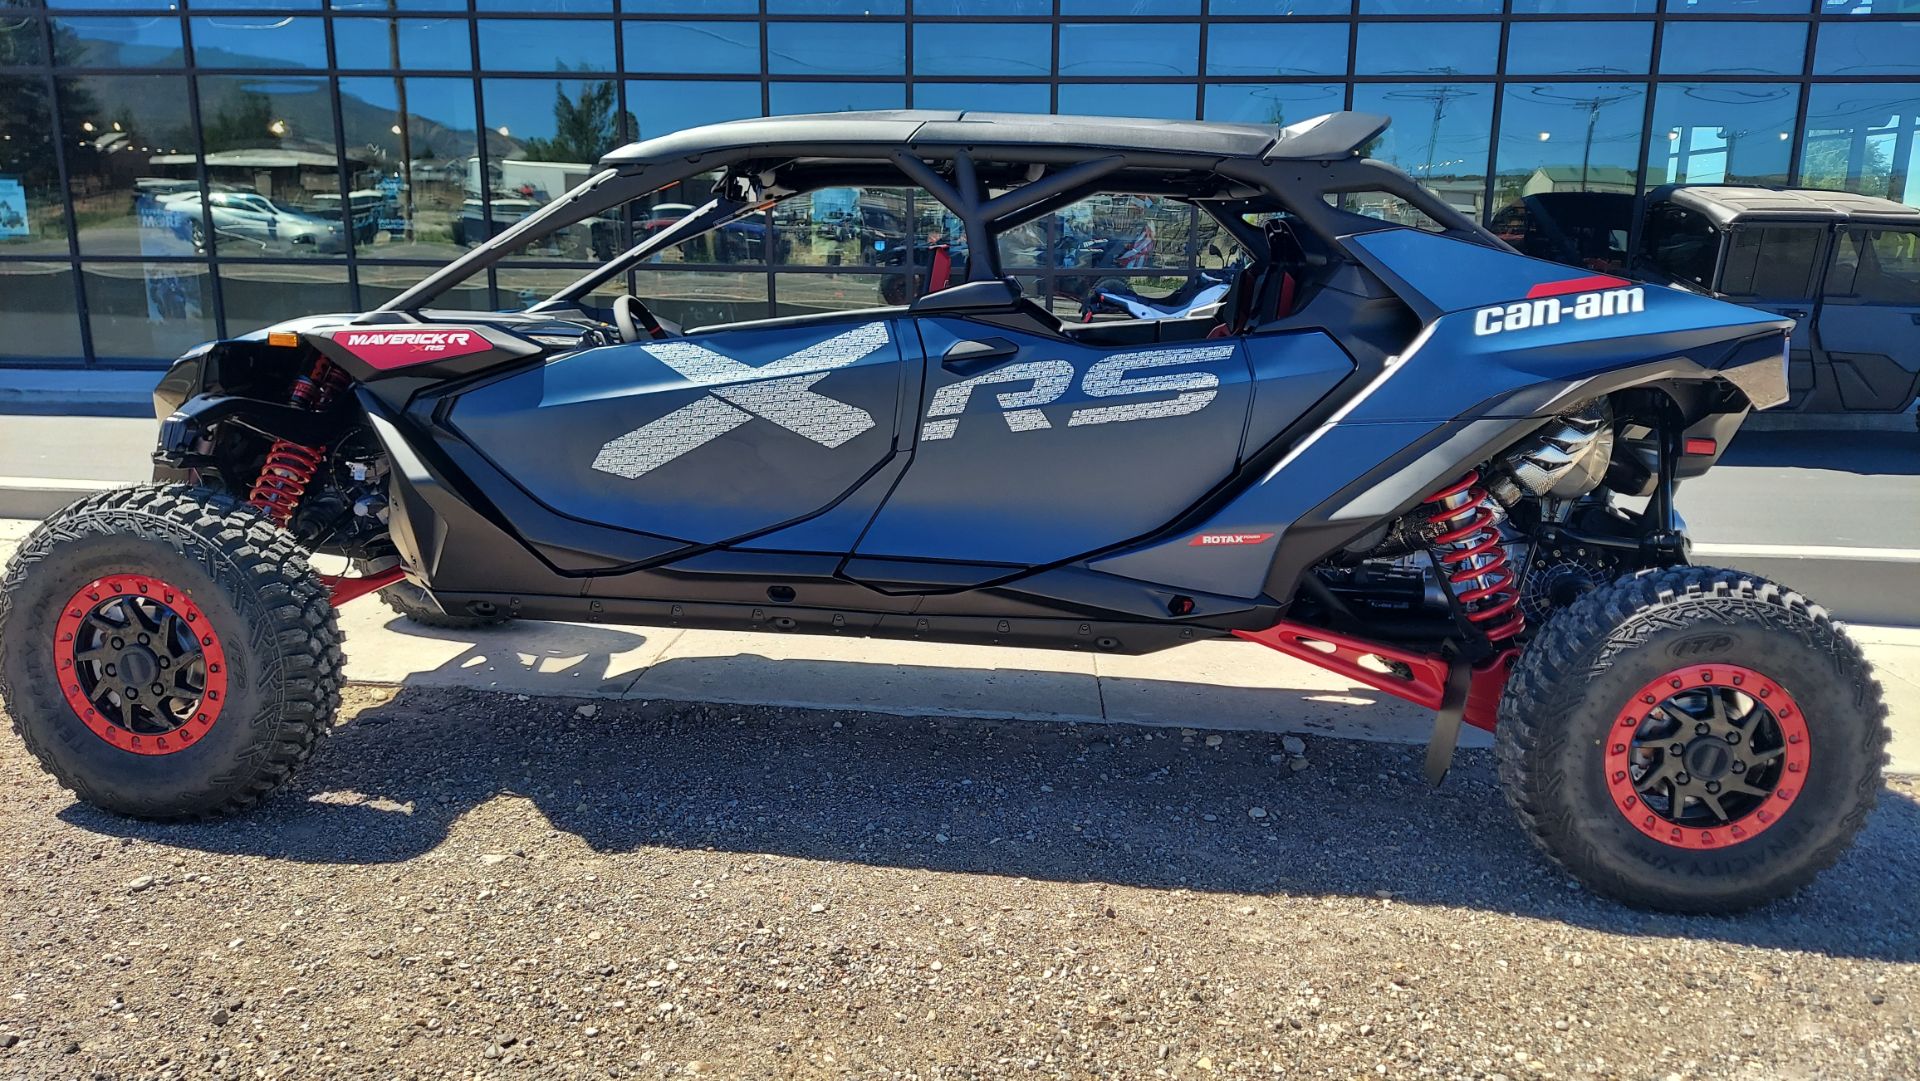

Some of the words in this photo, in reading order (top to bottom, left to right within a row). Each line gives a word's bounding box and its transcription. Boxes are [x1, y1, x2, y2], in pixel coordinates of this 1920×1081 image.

[1475, 287, 1645, 336] can-am
[348, 333, 448, 346] MAVERICK
[447, 333, 470, 346] R
[1202, 535, 1243, 544] ROTAX
